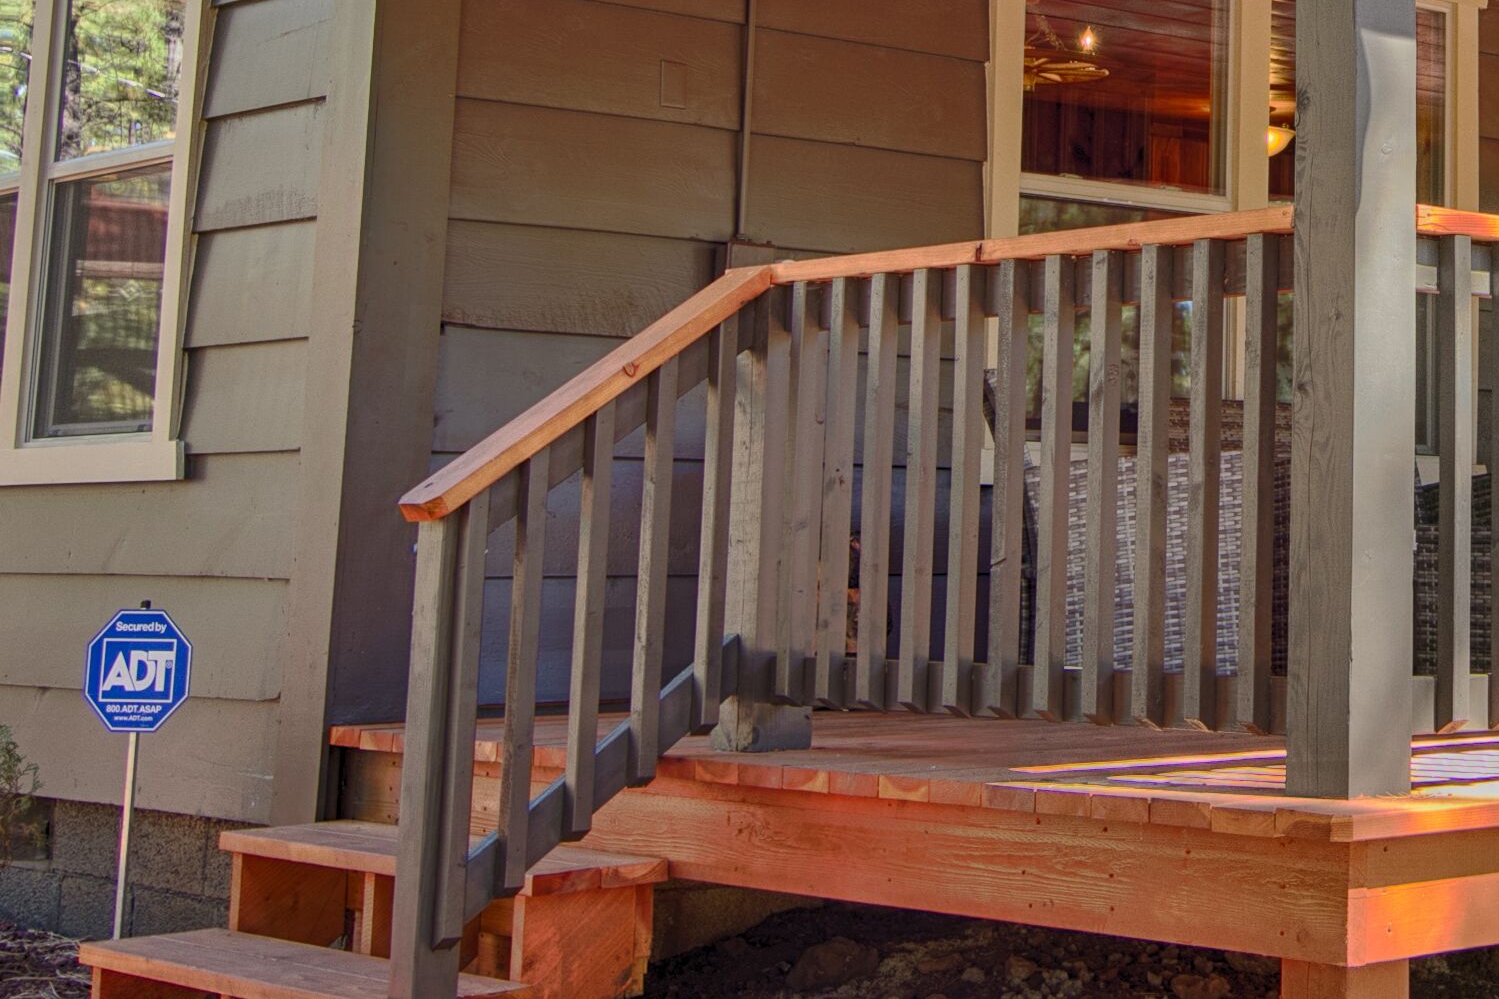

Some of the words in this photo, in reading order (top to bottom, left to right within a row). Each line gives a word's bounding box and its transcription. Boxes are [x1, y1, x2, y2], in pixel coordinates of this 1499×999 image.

[115, 621, 155, 632] Secured
[155, 622, 168, 634] by
[102, 650, 176, 692] ADT
[106, 704, 162, 714] 800.ADT.ASAP
